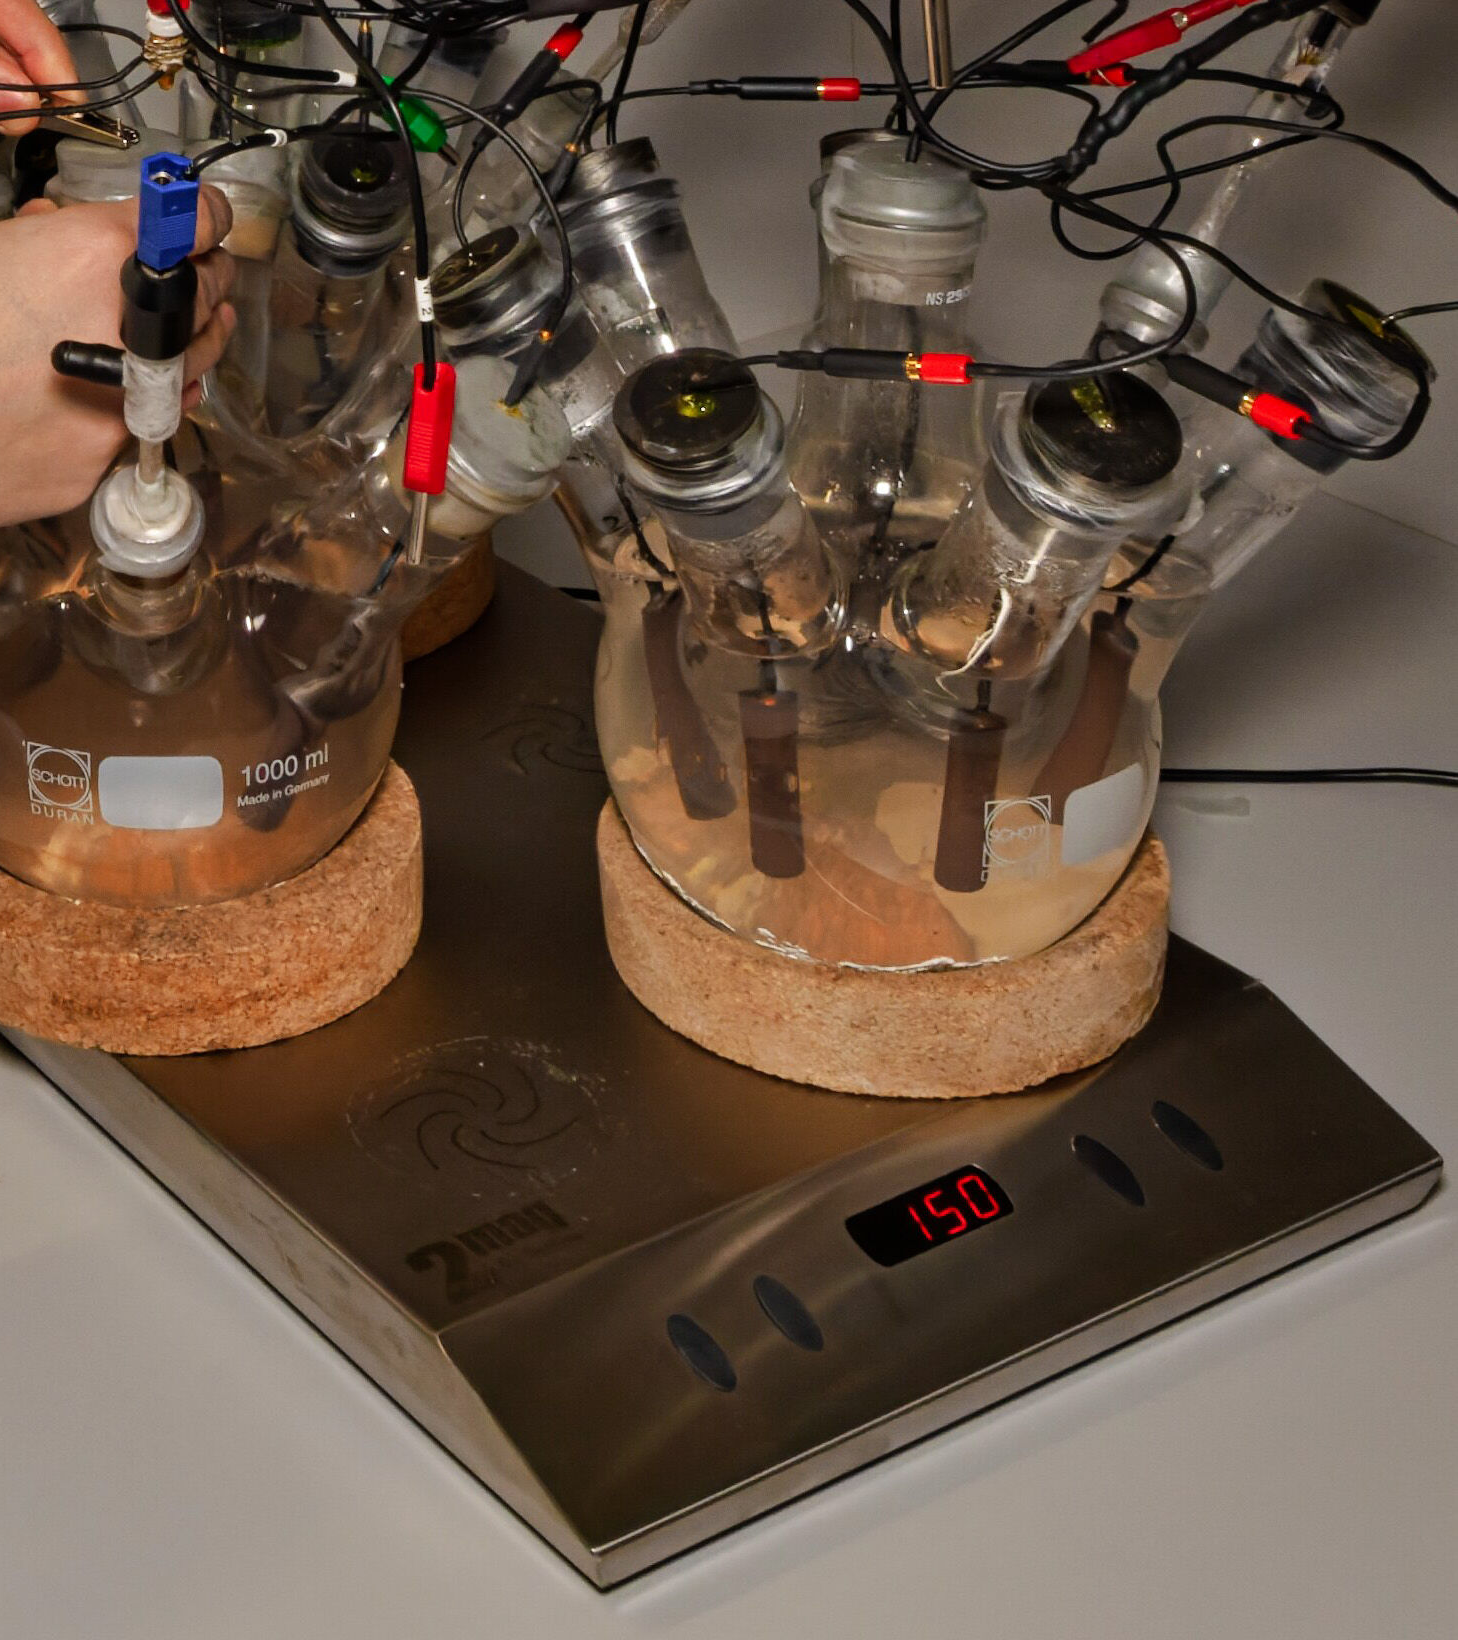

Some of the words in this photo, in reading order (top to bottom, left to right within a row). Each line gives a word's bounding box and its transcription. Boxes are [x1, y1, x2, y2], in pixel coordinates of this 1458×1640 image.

[925, 292, 944, 306] NS
[241, 754, 298, 787] 1000
[305, 742, 329, 771] ml
[31, 768, 85, 790] SCHOTT
[237, 792, 270, 807] Made
[272, 789, 283, 799] in
[284, 773, 330, 796] Germany
[31, 802, 94, 825] DURAN
[908, 1174, 1001, 1241] 150
